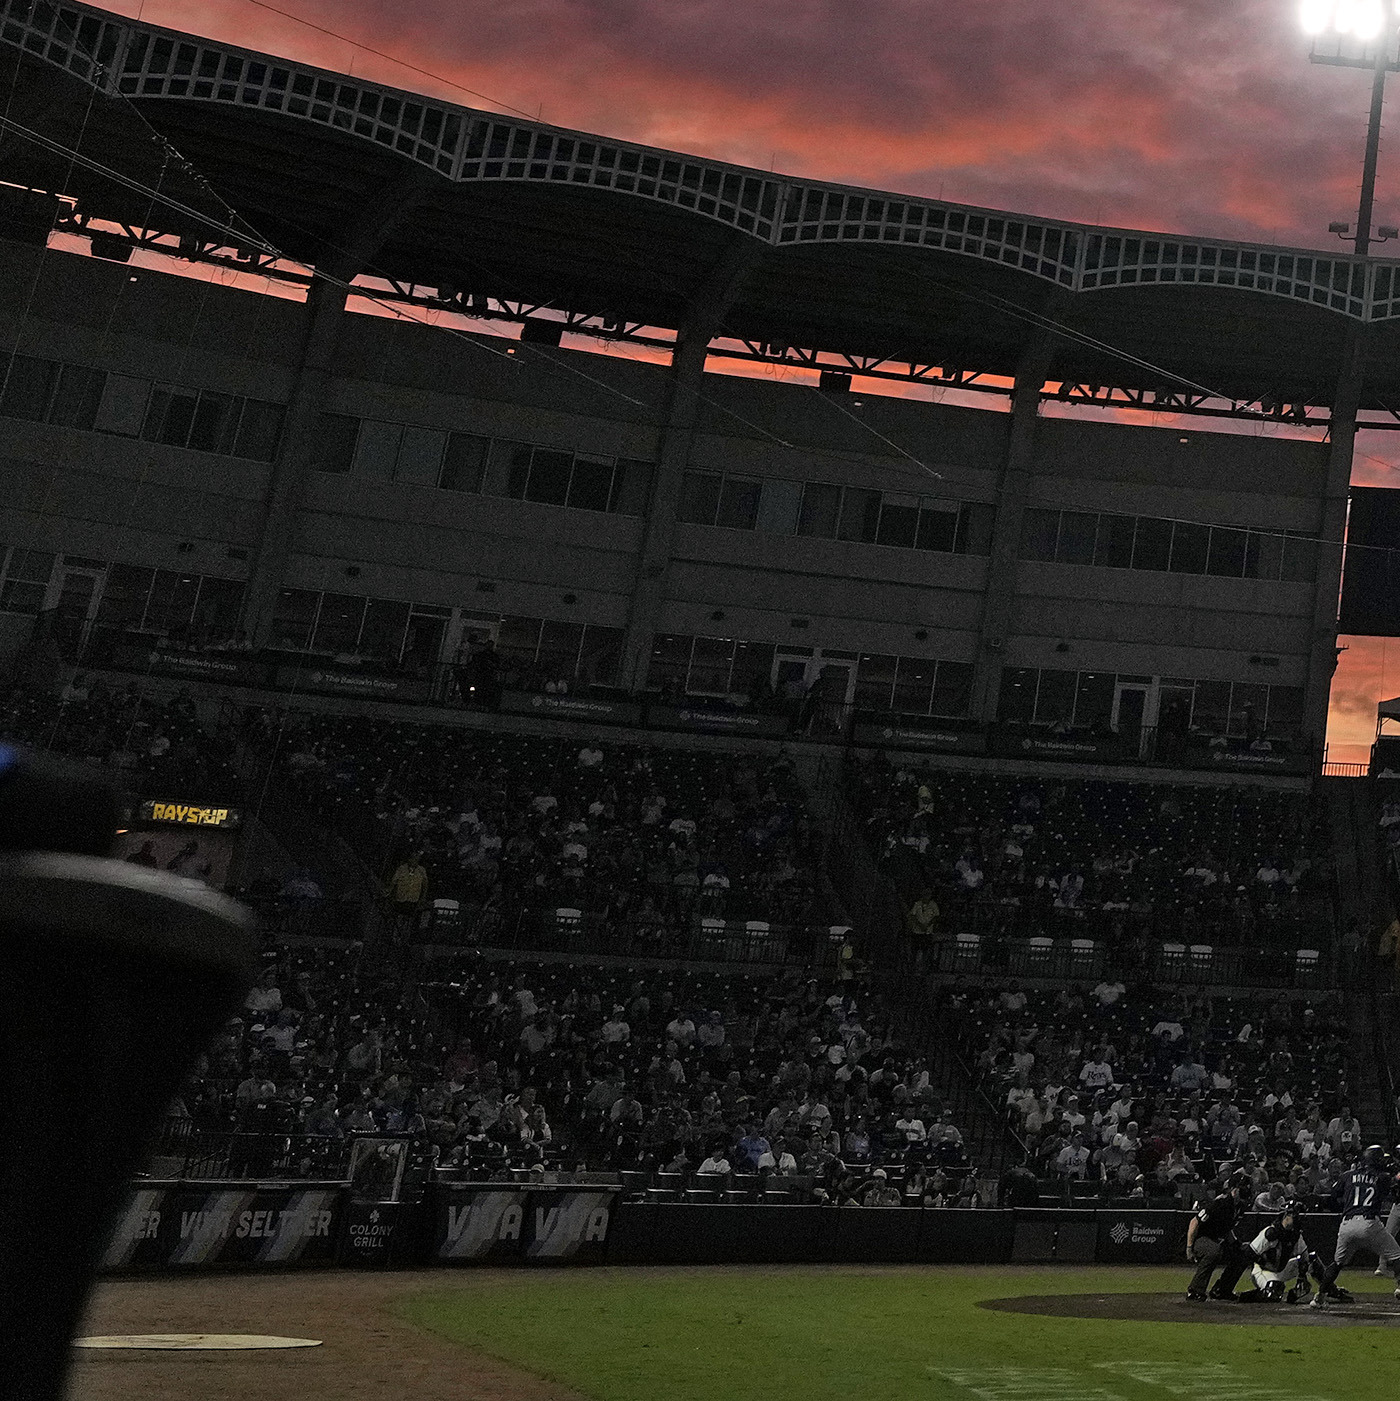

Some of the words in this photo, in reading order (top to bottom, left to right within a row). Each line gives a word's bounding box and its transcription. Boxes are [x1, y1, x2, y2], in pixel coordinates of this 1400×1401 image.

[1352, 1186, 1375, 1207] 12
[180, 1210, 232, 1239] VA
[236, 1210, 333, 1239] SELTER
[350, 1223, 394, 1237] COLONY
[448, 1204, 524, 1241] VA
[535, 1206, 610, 1242] VA
[1132, 1226, 1164, 1236] Baldwin
[353, 1236, 384, 1248] GRILL
[1131, 1235, 1157, 1245] Group
